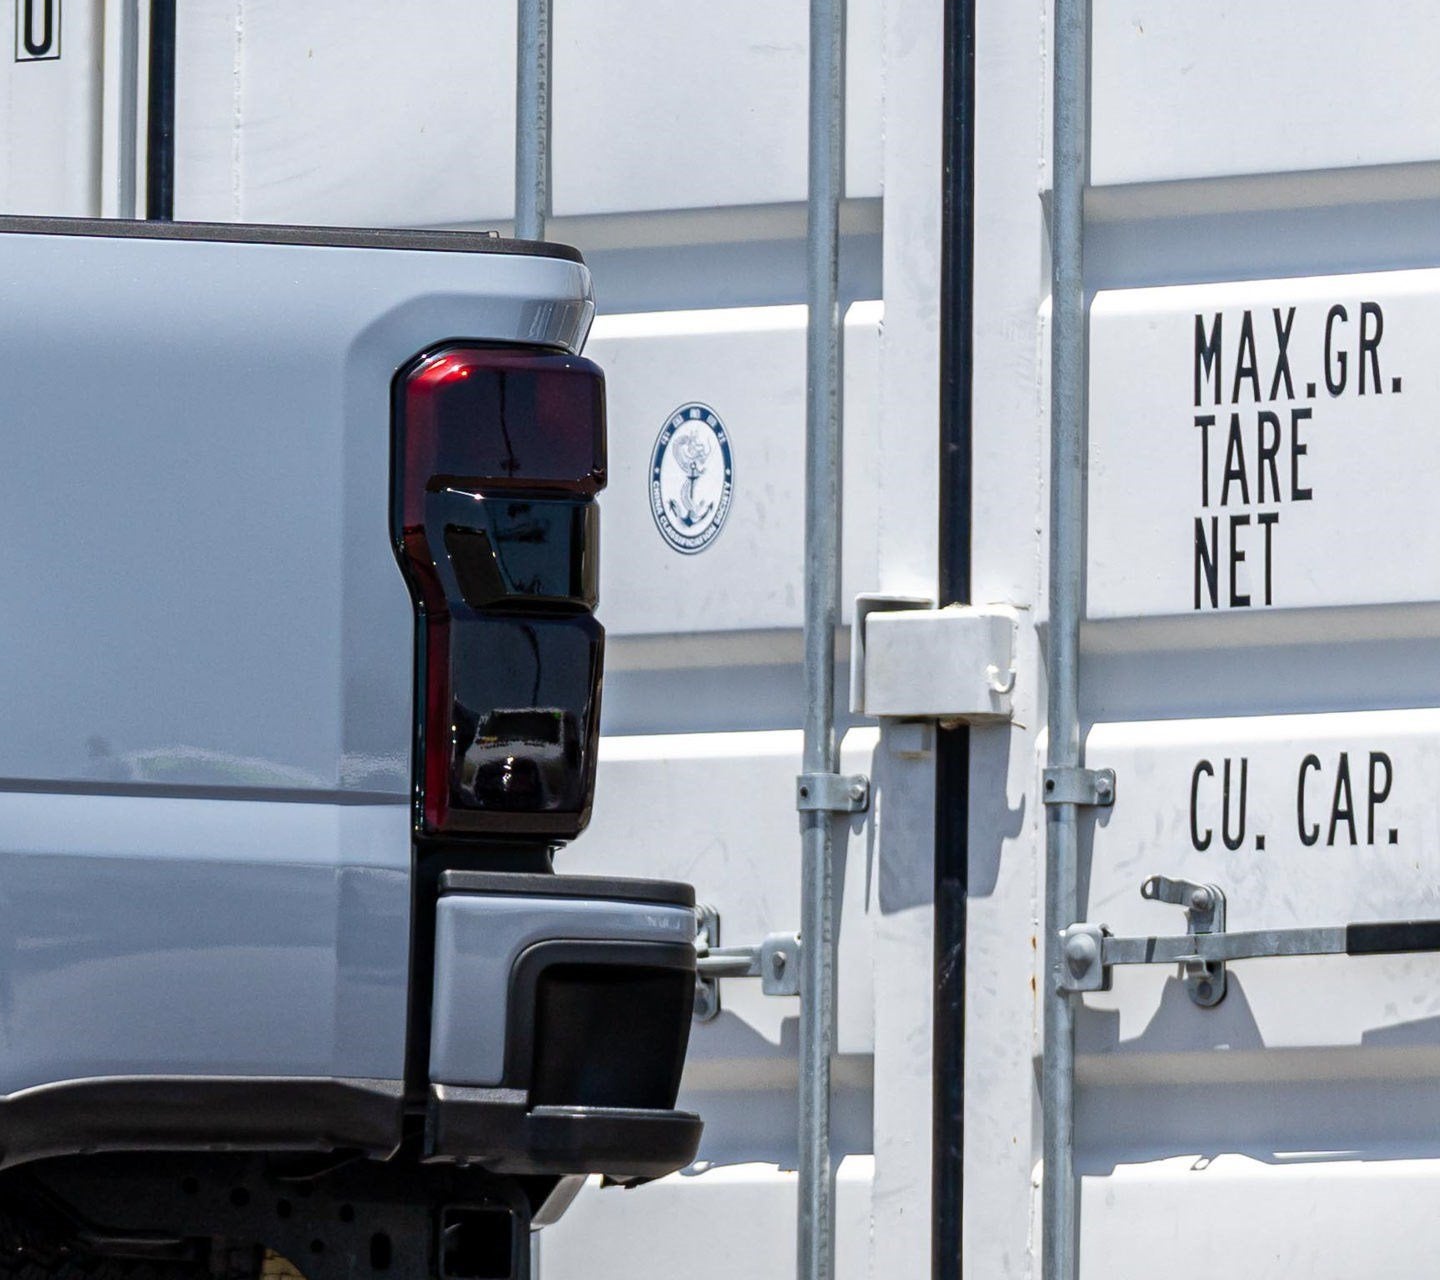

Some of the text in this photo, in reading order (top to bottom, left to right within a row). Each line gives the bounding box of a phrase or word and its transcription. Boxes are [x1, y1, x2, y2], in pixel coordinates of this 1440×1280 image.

[1193, 301, 1403, 407] MAX.GR.
[653, 481, 662, 515] CHINA
[1194, 408, 1314, 508] TARE
[1193, 511, 1279, 610] NET
[1189, 757, 1266, 852] CU.
[1296, 750, 1399, 846] CAP.
